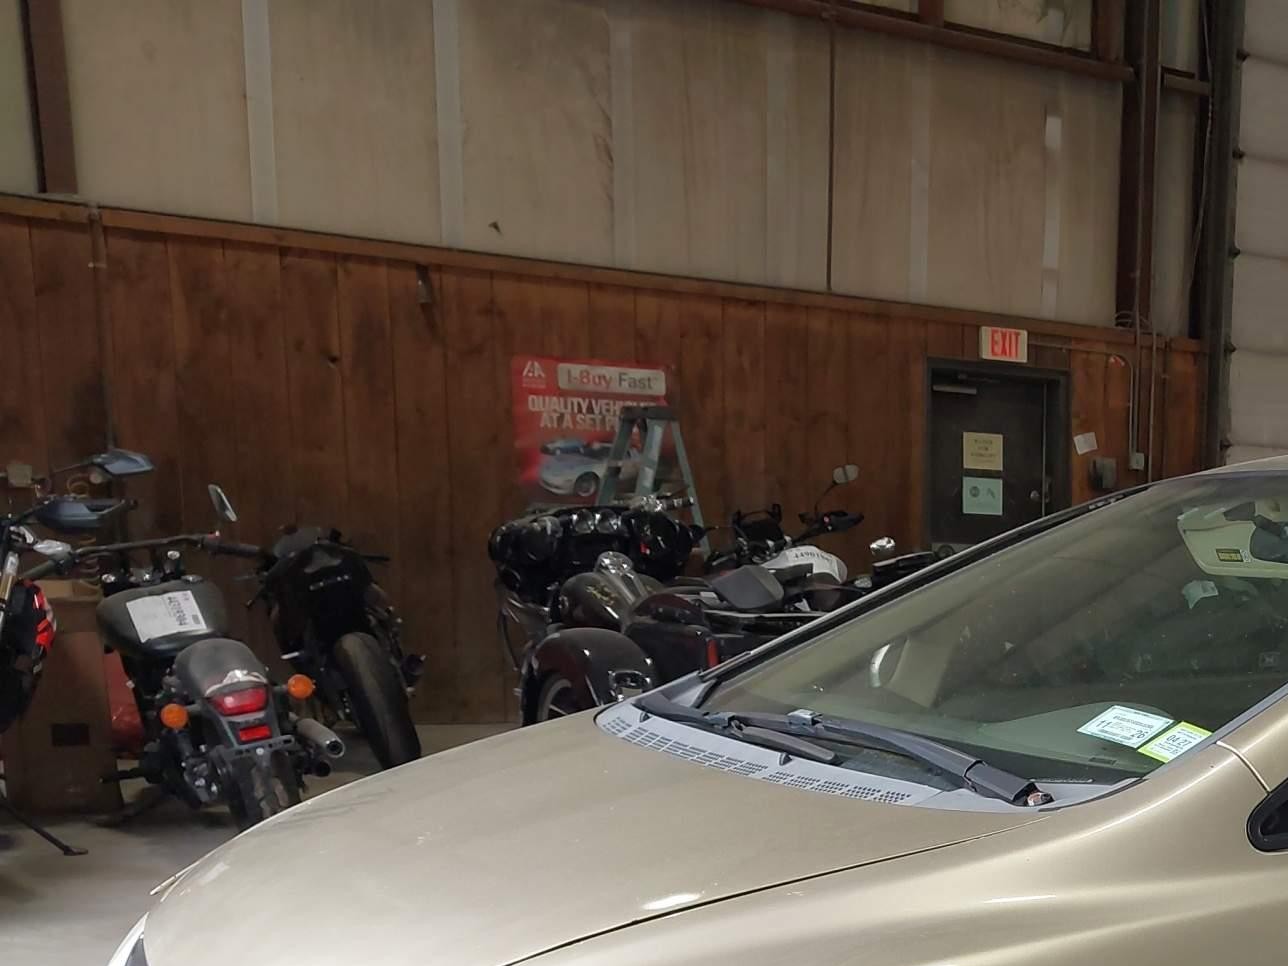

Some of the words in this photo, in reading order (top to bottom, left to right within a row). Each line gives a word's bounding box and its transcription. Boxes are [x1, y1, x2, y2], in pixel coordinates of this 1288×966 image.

[991, 328, 1021, 359] EXIT
[566, 368, 613, 390] I-Buy
[527, 395, 589, 415] QUALITY
[540, 412, 561, 429] AT
[562, 413, 574, 430] A
[576, 414, 602, 432] SET
